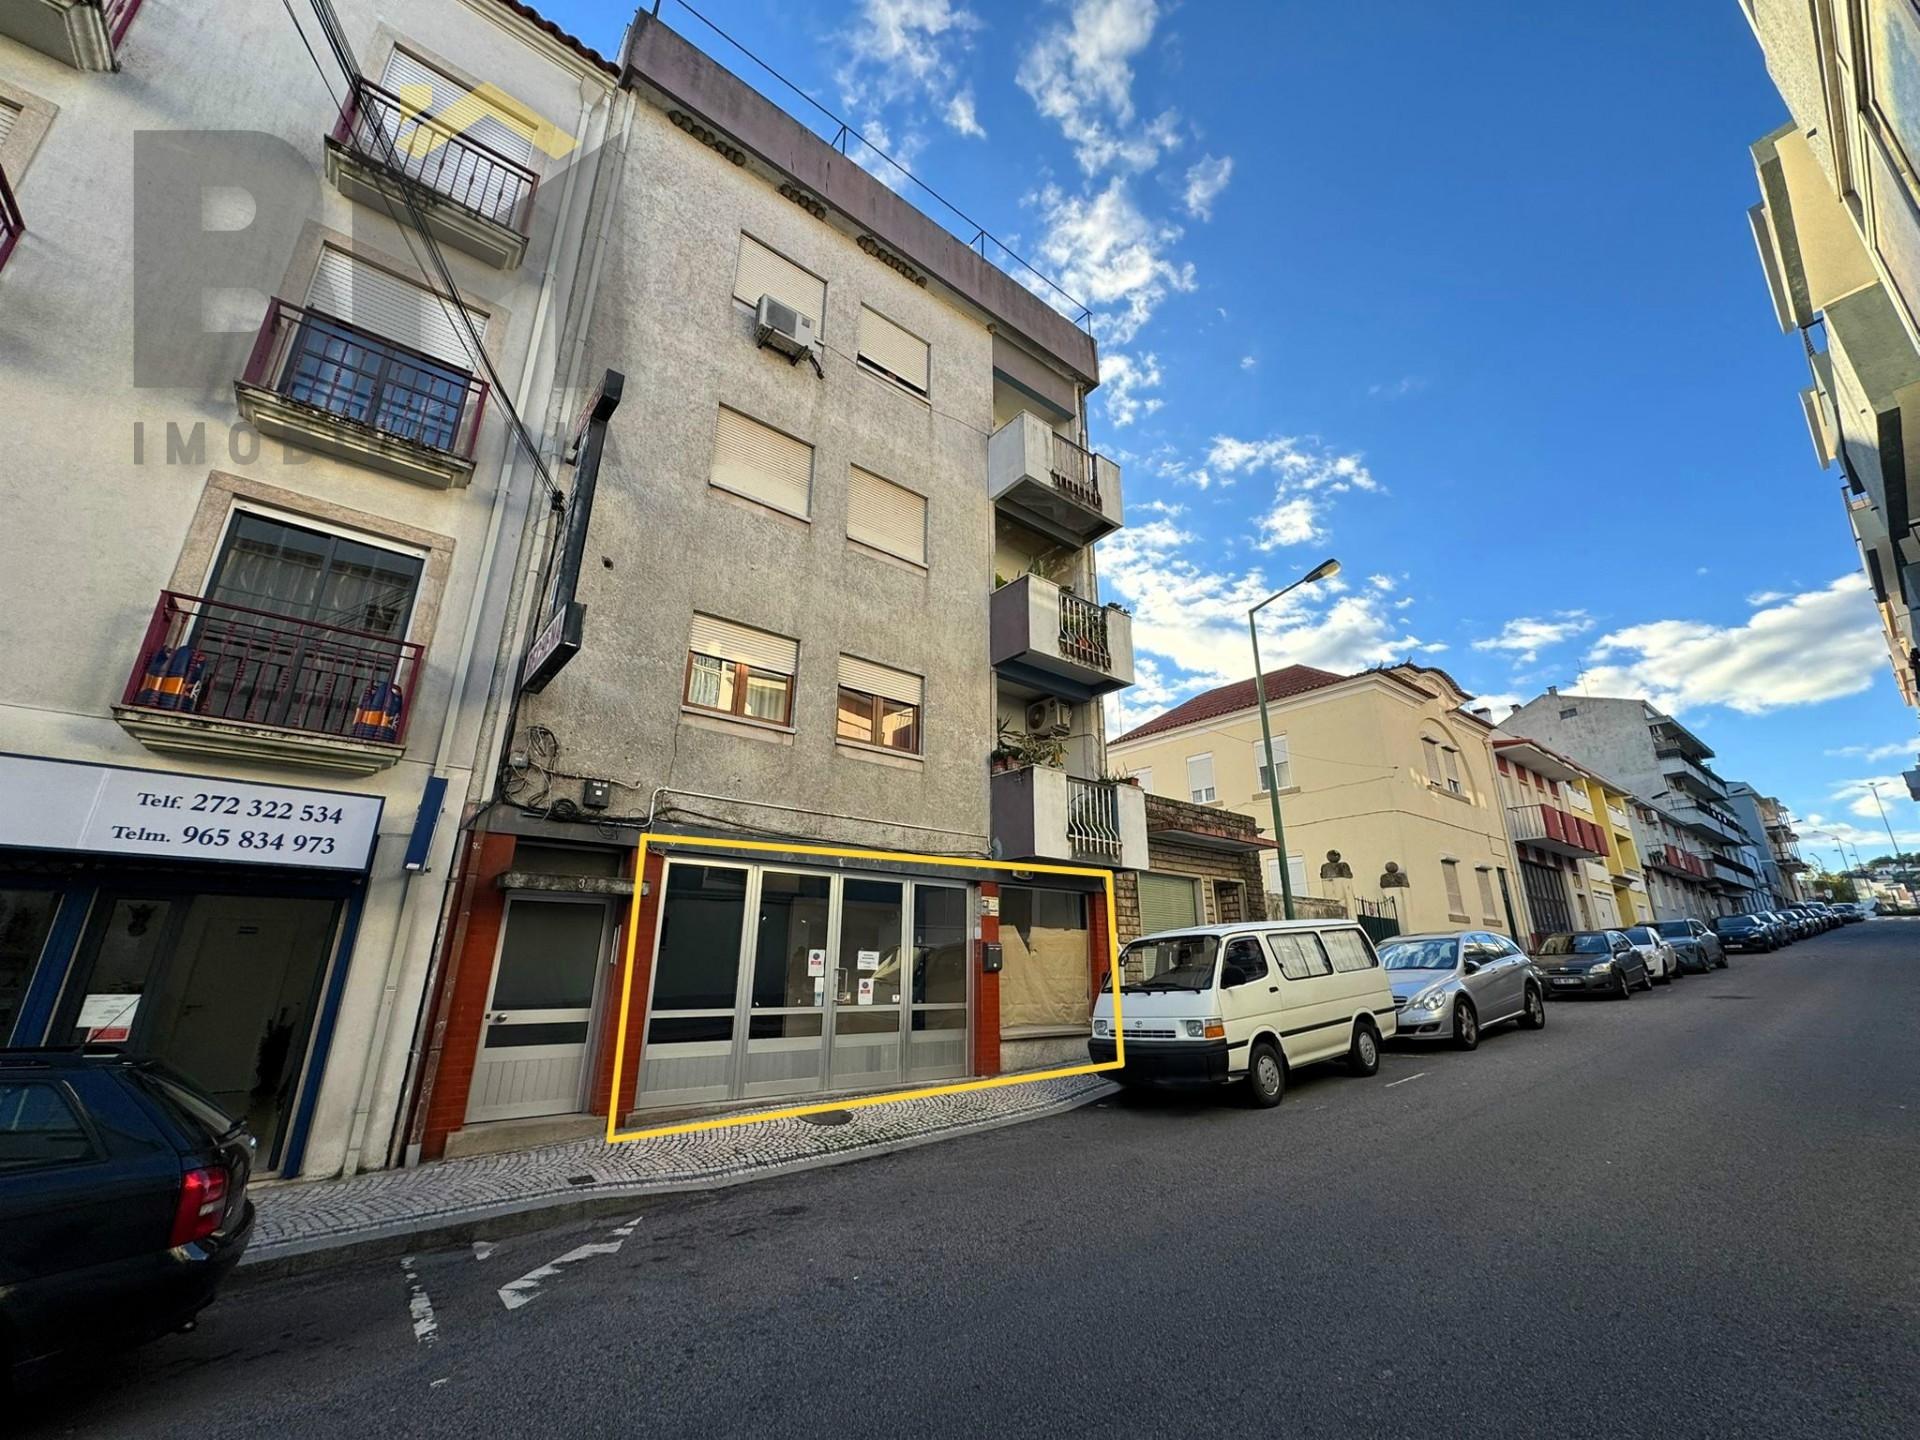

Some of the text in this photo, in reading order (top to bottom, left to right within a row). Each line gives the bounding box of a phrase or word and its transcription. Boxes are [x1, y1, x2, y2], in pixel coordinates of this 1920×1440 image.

[137, 792, 343, 824] Telf. 272 322 534
[112, 825, 335, 855] Telm. 965 834 973
